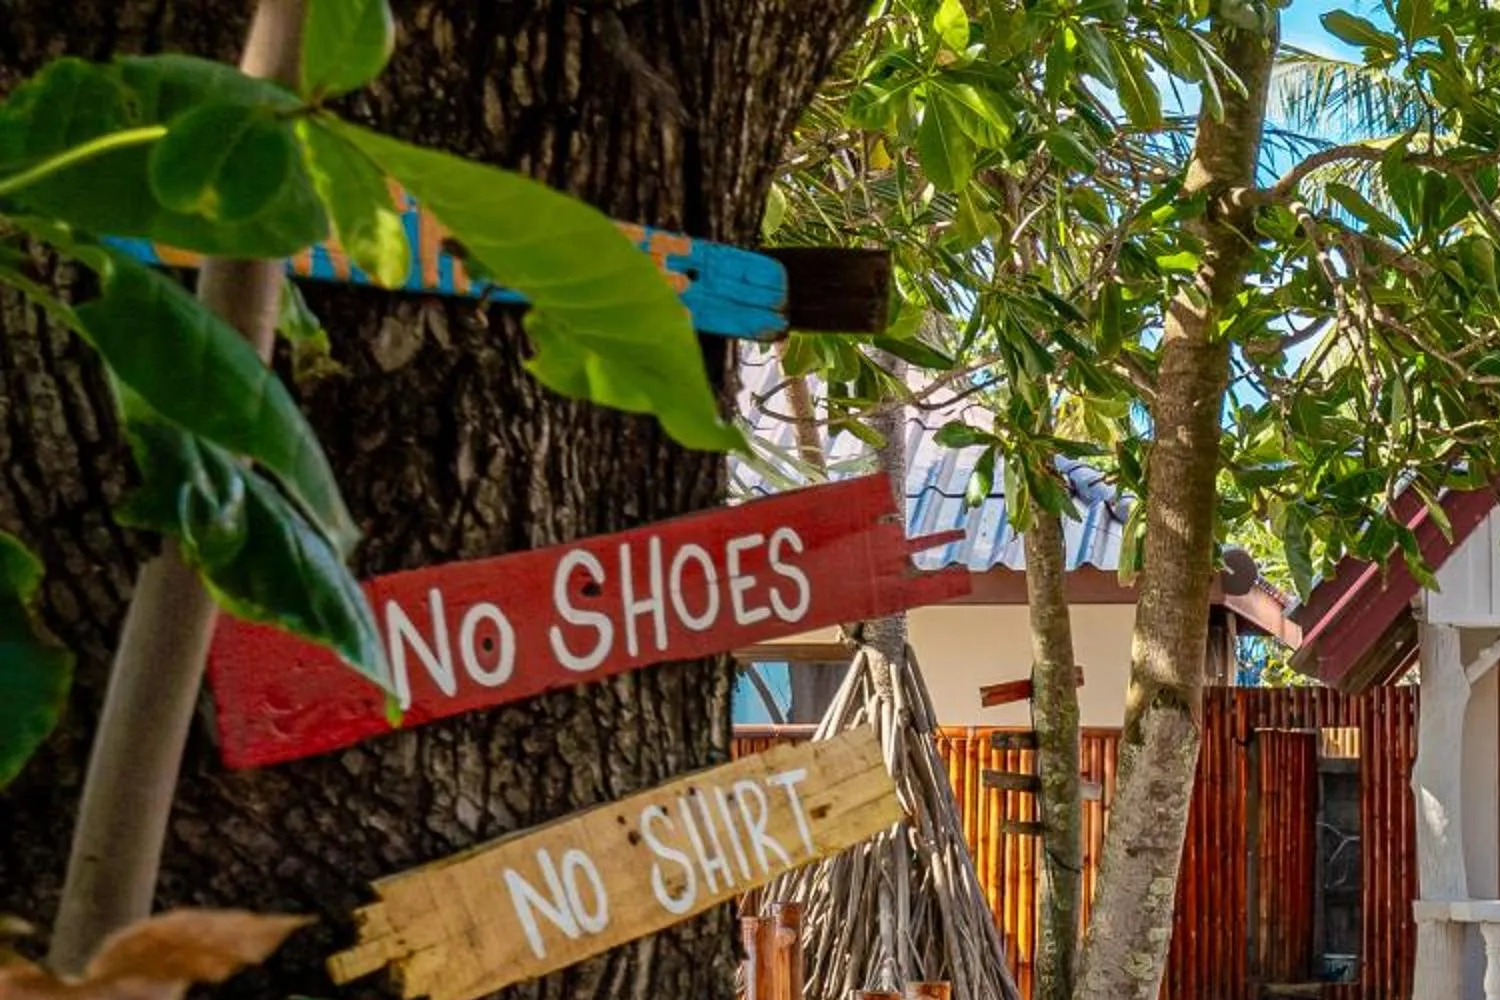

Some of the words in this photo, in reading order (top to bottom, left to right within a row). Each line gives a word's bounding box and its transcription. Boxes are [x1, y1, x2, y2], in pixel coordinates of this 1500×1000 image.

[386, 588, 516, 711] NO
[549, 527, 812, 673] SHOES
[503, 847, 610, 960] NO
[638, 768, 818, 915] SHIRT
